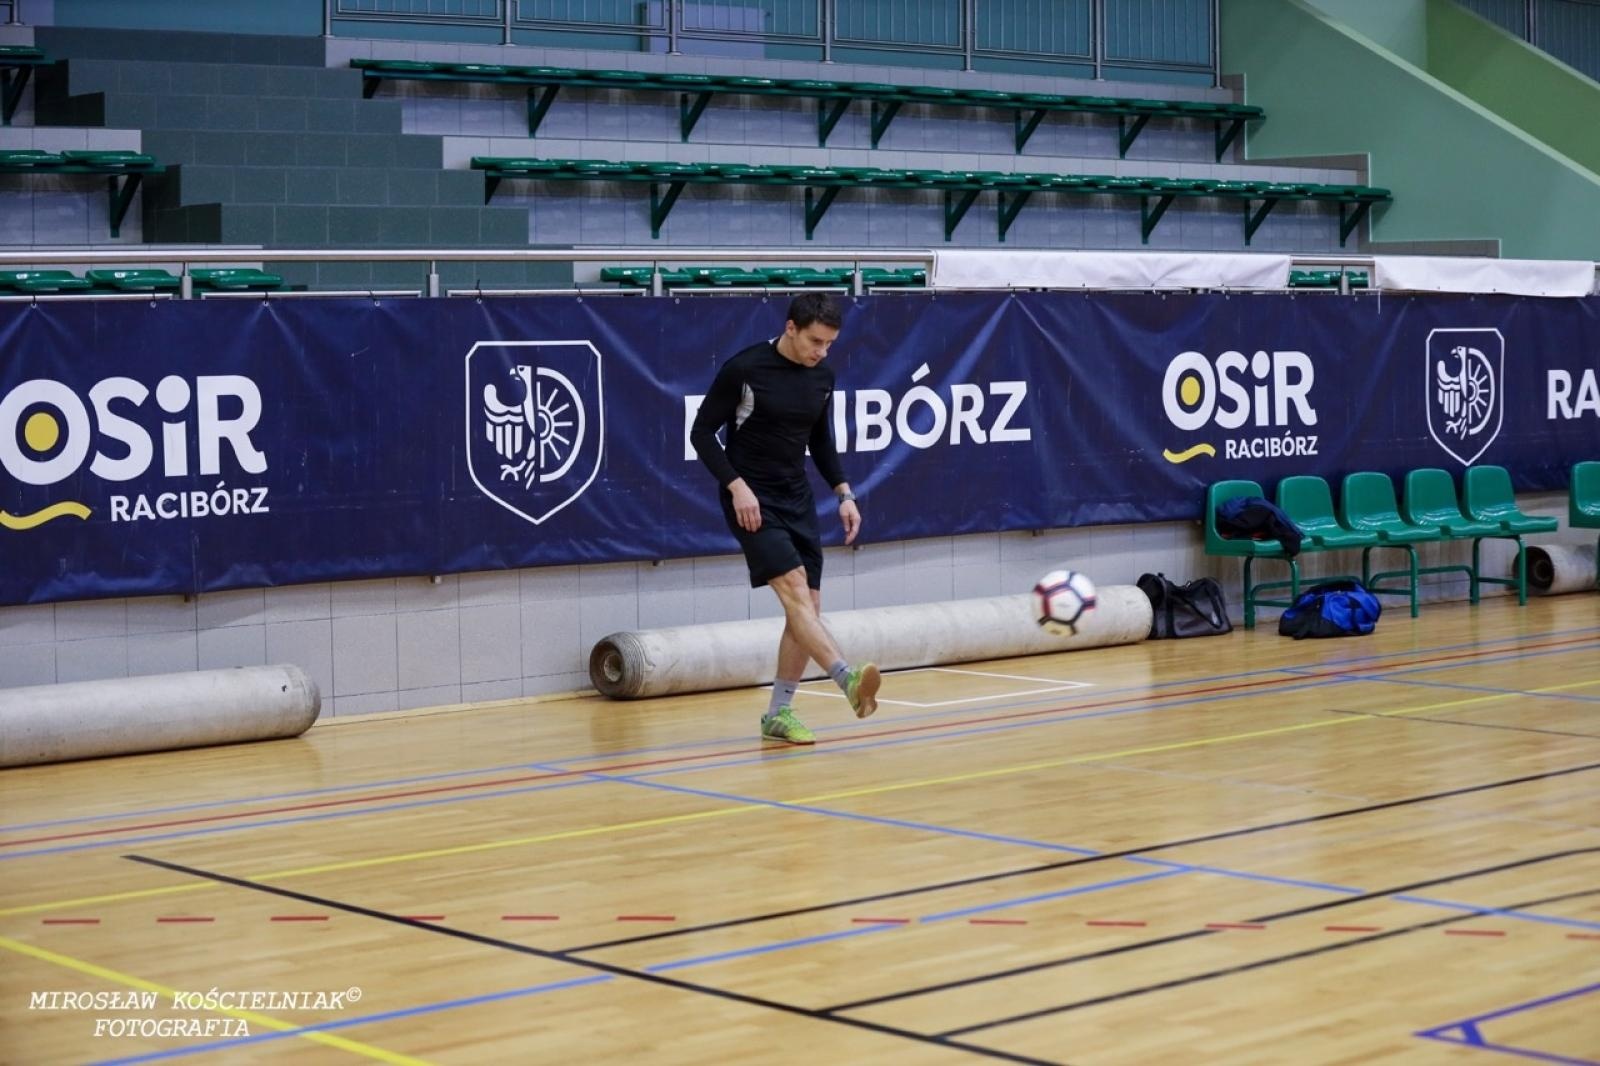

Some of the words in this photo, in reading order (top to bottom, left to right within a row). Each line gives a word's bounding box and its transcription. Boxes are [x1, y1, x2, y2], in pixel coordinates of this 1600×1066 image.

[684, 362, 1031, 461] IBÓRZ
[1224, 430, 1318, 460] RACIBÓRZ
[110, 481, 269, 522] RACIBÓRZ
